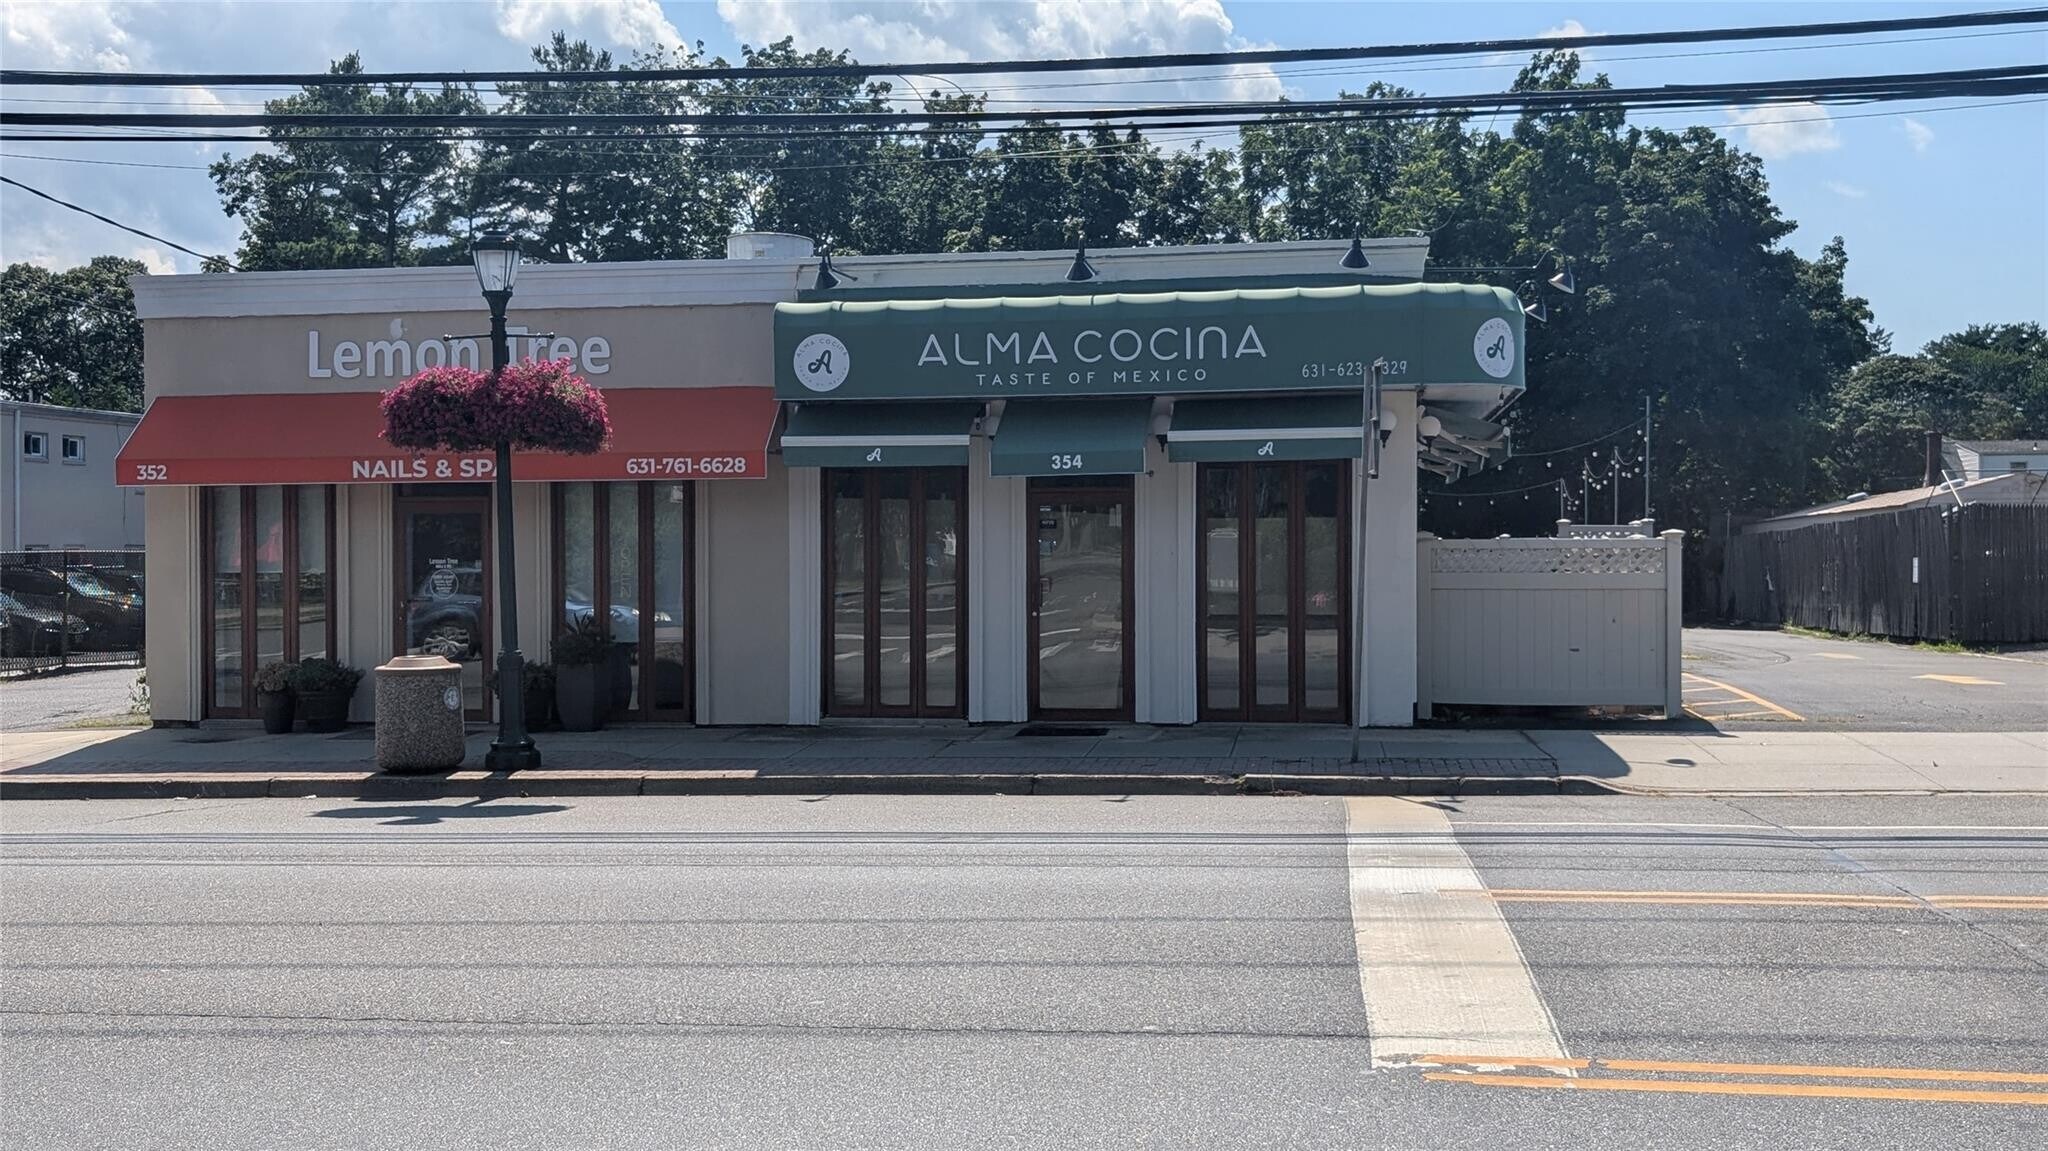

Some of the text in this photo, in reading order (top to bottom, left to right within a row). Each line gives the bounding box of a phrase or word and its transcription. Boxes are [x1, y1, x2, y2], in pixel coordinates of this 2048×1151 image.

[308, 326, 611, 378] Lemon Tree
[917, 324, 1266, 366] ALMA COCINA
[1486, 335, 1505, 360] A
[808, 350, 832, 374] A
[975, 368, 1207, 386] TASTE OF MEXICO
[352, 459, 497, 478] NAILS & SP
[626, 457, 746, 474] 631-761-6628
[1051, 454, 1083, 469] 354
[136, 464, 168, 480] 352
